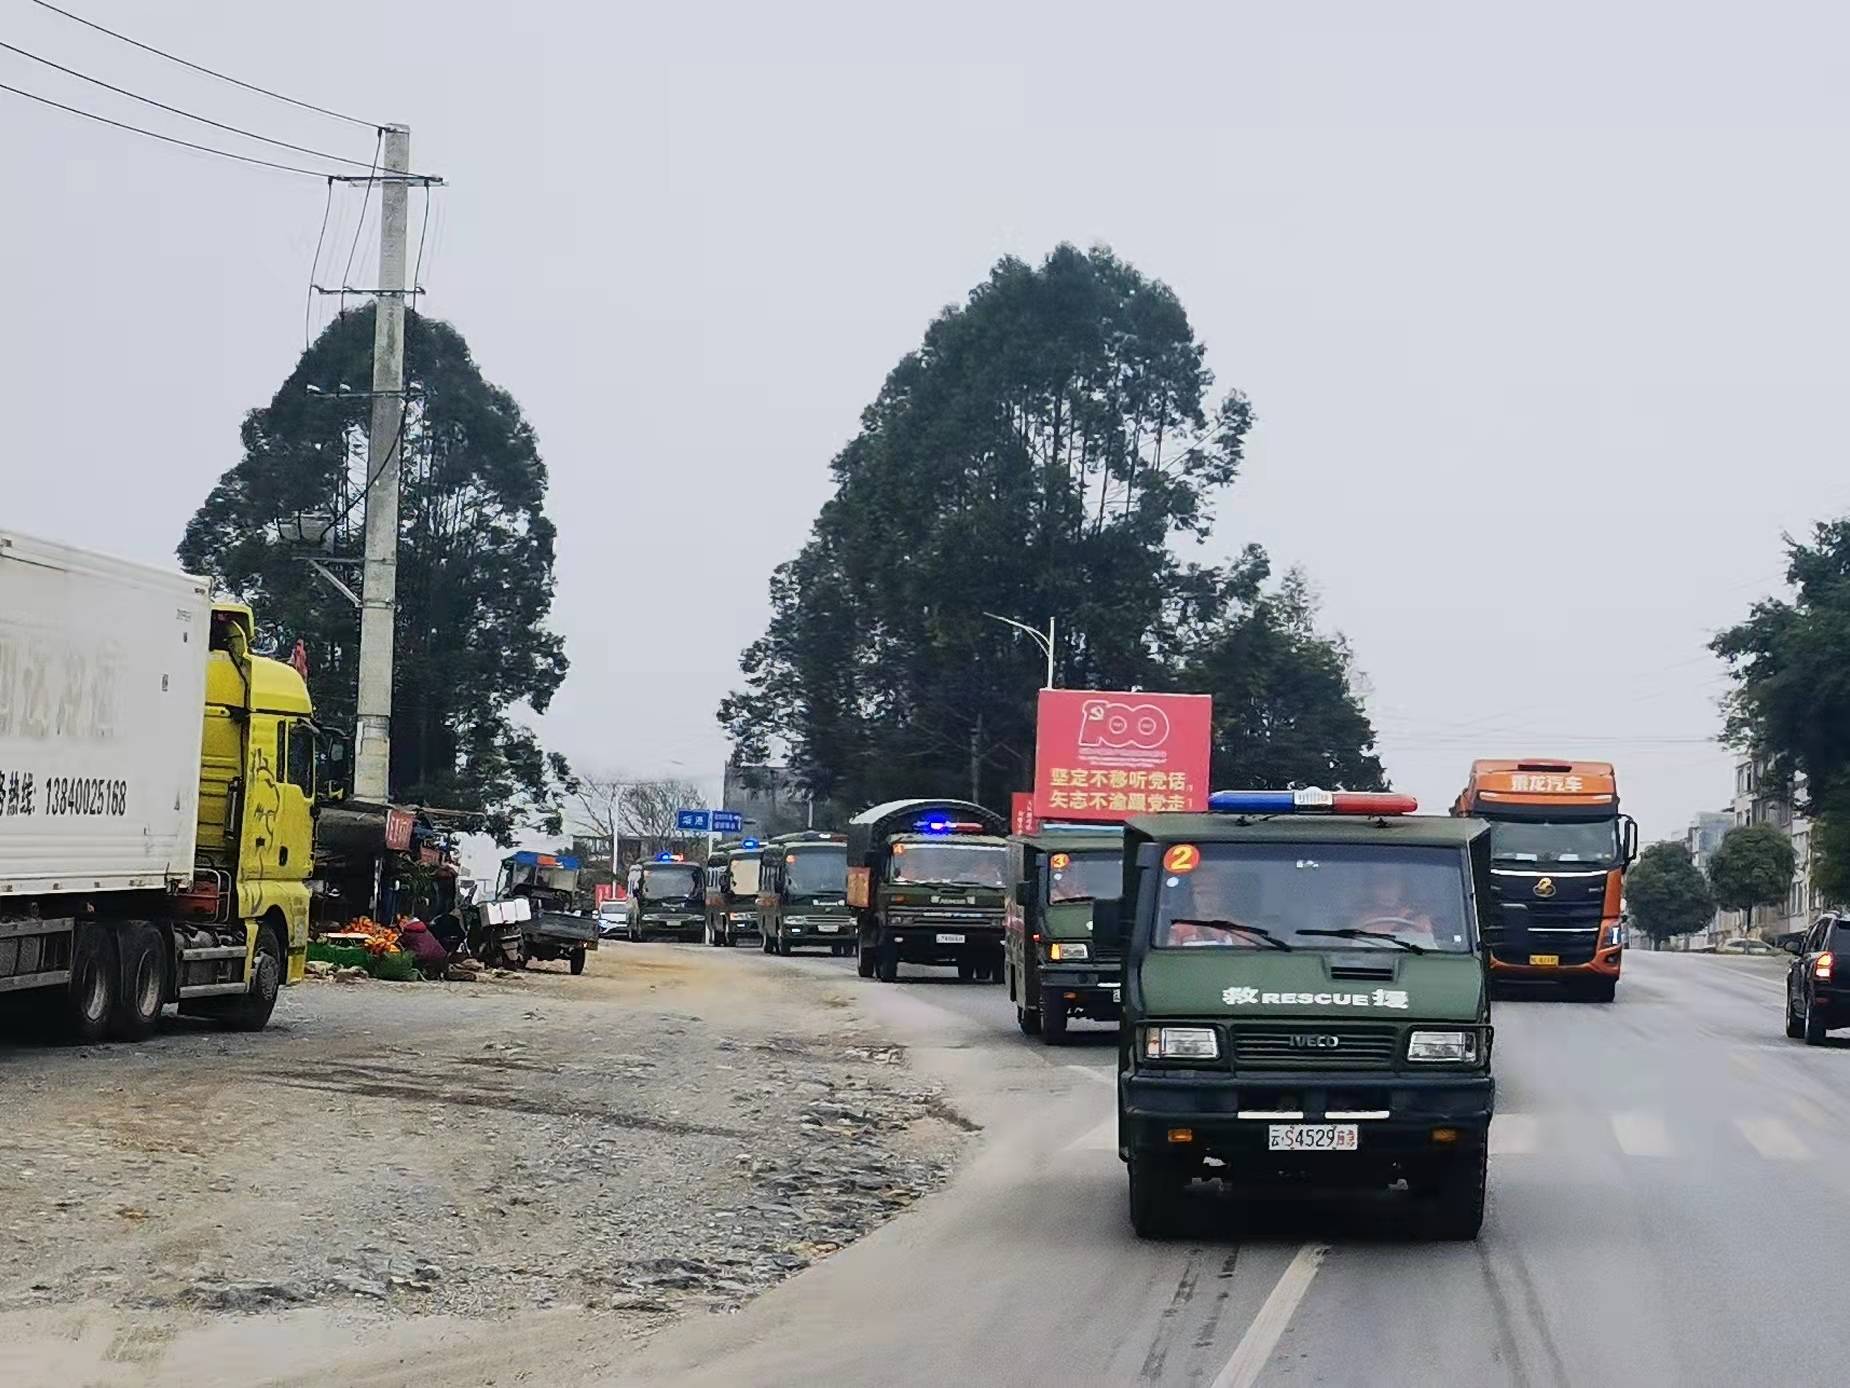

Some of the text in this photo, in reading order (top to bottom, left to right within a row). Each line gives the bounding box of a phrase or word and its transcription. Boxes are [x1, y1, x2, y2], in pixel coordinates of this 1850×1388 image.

[46, 777, 127, 816] 13840025168
[1053, 855, 1066, 868] 3
[1171, 845, 1193, 870] 2
[1262, 992, 1369, 1006] RESCUE
[1289, 1034, 1339, 1047] IVECO
